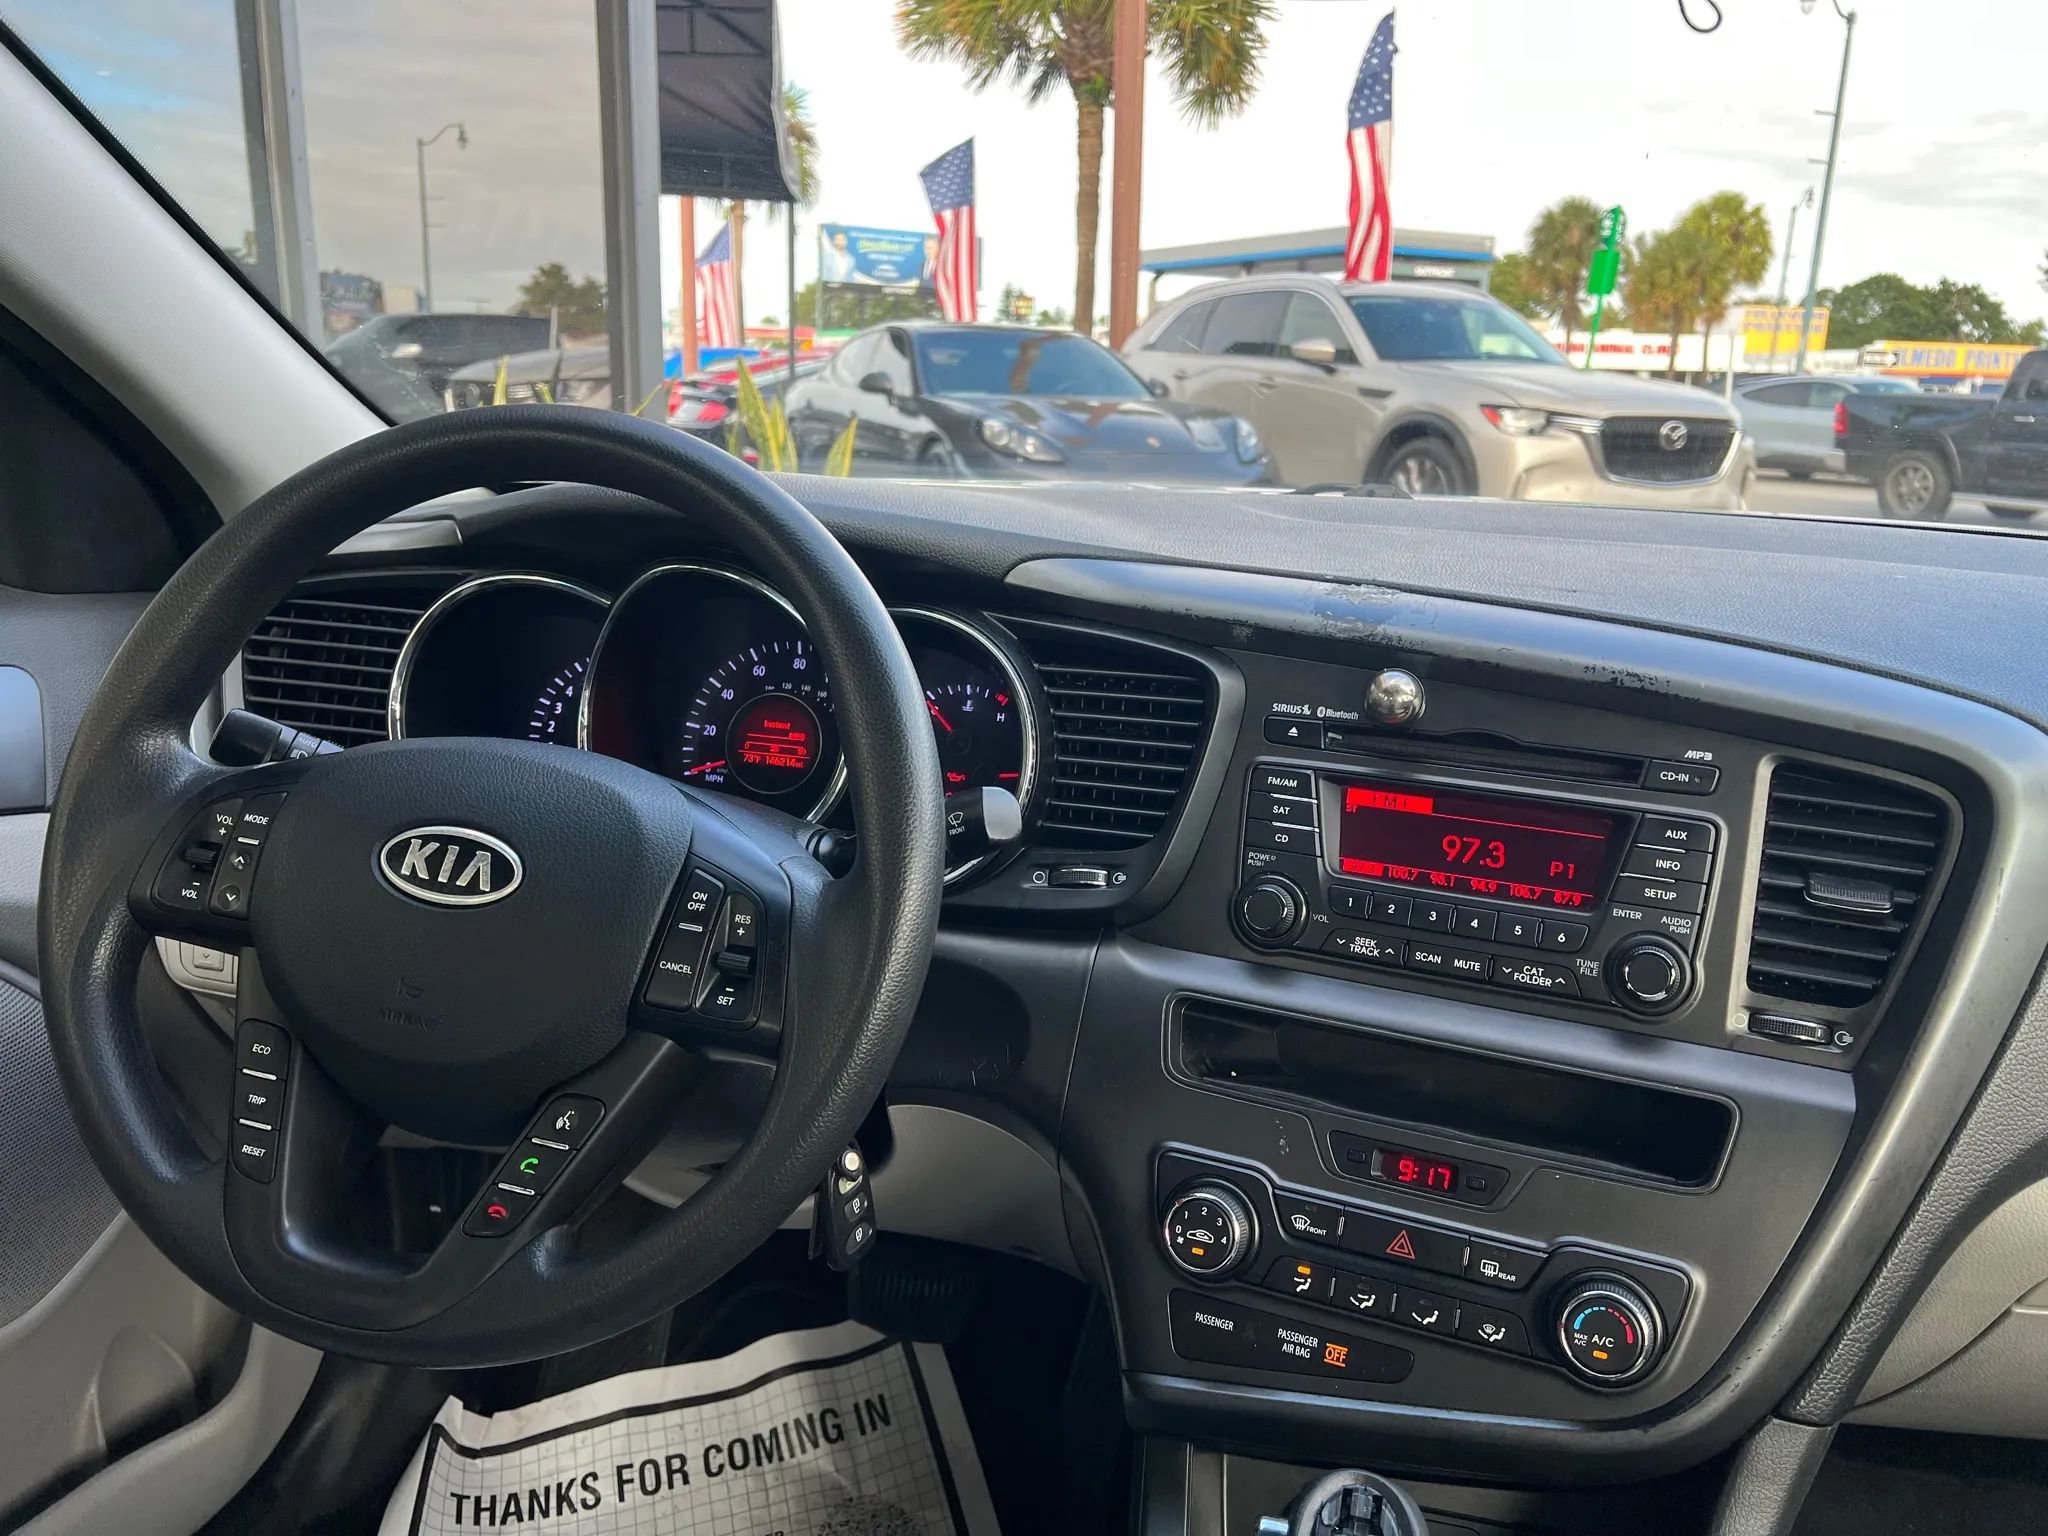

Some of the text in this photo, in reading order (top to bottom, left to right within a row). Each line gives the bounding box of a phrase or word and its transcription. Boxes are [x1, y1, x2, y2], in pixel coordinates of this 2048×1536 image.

[752, 664, 766, 676] 60
[792, 658, 806, 670] 80
[565, 686, 573, 698] 4
[782, 682, 792, 690] 120
[801, 684, 811, 692] 140
[720, 688, 734, 700] 40
[554, 702, 562, 714] 3
[1272, 702, 1302, 714] SIRIUS
[1325, 708, 1359, 720] Bluetooth
[996, 713, 1005, 722] H
[547, 720, 556, 733] 2
[703, 724, 717, 736] 20
[1684, 750, 1713, 761] MP3
[704, 773, 724, 784] MPH
[1267, 776, 1298, 788] FM/AM
[1660, 771, 1690, 783] CD-IN
[1272, 806, 1290, 815] SAT
[216, 813, 234, 826] VOL
[243, 813, 270, 826] MODE
[948, 826, 966, 836] FRONT
[1664, 828, 1688, 840] AUX
[1274, 834, 1289, 843] CD
[1248, 852, 1276, 862] POWER
[1442, 835, 1506, 869] 97.3
[400, 838, 492, 892] KIA
[1247, 858, 1264, 867] PUSH
[1655, 858, 1680, 871] INFO
[1388, 866, 1420, 881] 100.7
[1470, 878, 1497, 893] 94.9
[1554, 890, 1582, 906] 87.9
[181, 888, 198, 900] VOL
[692, 891, 708, 901] ON
[1644, 888, 1677, 900] SETUP
[687, 901, 706, 912] OFF
[1348, 898, 1353, 908] 1
[1387, 904, 1395, 914] 2
[734, 914, 752, 924] RES
[1312, 913, 1329, 923] VOL
[1428, 911, 1437, 922] 3
[1612, 908, 1642, 920] ENTER
[1470, 918, 1479, 929] 4
[1660, 916, 1692, 928] AUDIO
[1514, 925, 1522, 936] 5
[1669, 924, 1690, 935] PUSH
[1354, 936, 1378, 948] SEEK
[1557, 932, 1566, 943] 6
[1349, 944, 1380, 958] TRACK
[1415, 952, 1442, 964] SCAN
[1575, 958, 1600, 969] TUNE
[659, 960, 692, 974] CANCEL
[1454, 959, 1481, 972] MUTE
[1523, 966, 1544, 977] CAT
[1580, 966, 1599, 977] FILE
[1513, 973, 1552, 988] FOLDER
[716, 995, 736, 1006] SET
[252, 1043, 271, 1055] ECO
[247, 1094, 267, 1106] TRIP
[241, 1144, 267, 1158] RESET
[1398, 1158, 1453, 1191] 9:17
[1184, 1210, 1189, 1220] 1
[1201, 1206, 1208, 1216] 2
[1216, 1217, 1223, 1227] 3
[1175, 1225, 1182, 1234] 0
[1306, 1225, 1327, 1236] FRONT
[1220, 1236, 1227, 1245] 4
[1498, 1272, 1516, 1282] REAR
[1194, 1312, 1234, 1332] PASSENGER
[1277, 1328, 1318, 1348] PASSENGER
[1574, 1332, 1588, 1341] MAX
[1574, 1338, 1587, 1346] A/C
[1592, 1334, 1614, 1348] A/C
[1281, 1343, 1311, 1359] AIR BAG
[1324, 1348, 1346, 1364] OFF
[449, 1392, 893, 1528] THANKS FOR COMING IN
